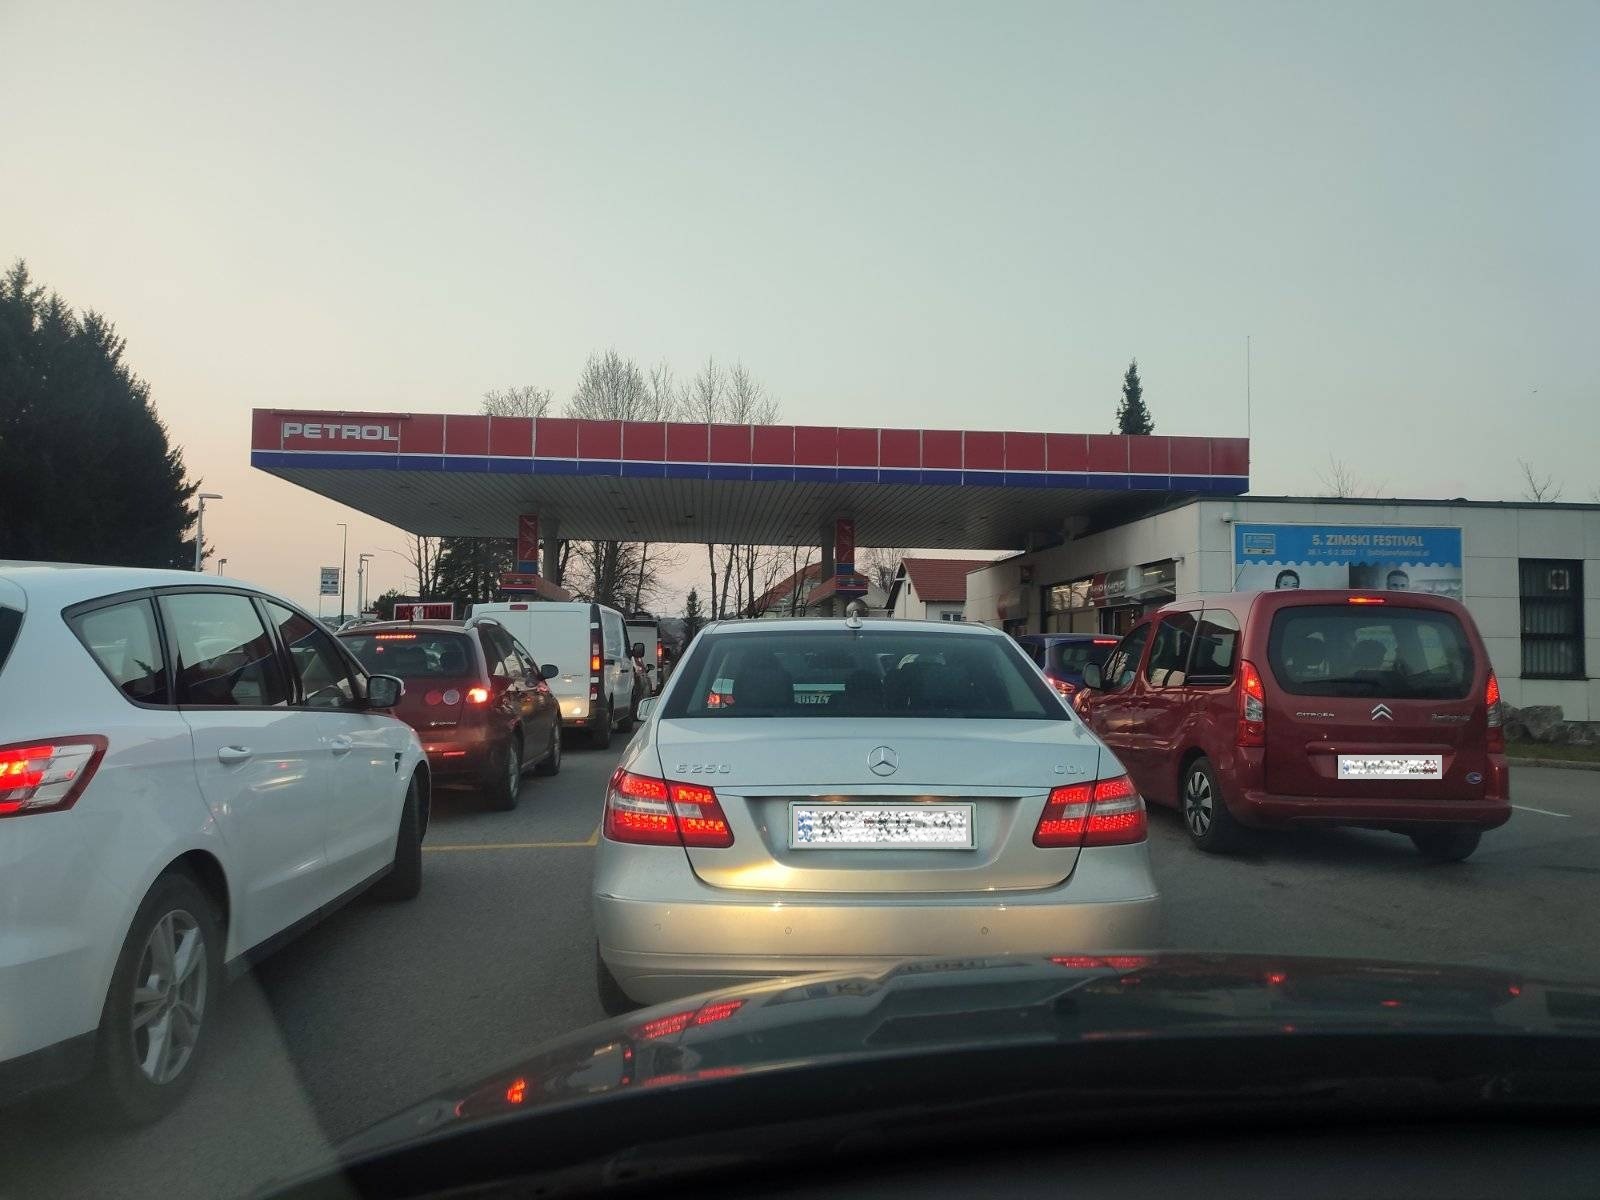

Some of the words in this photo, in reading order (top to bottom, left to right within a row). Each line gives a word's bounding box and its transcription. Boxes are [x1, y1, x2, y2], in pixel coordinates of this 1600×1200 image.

[283, 422, 399, 441] PETROL
[1312, 534, 1323, 546] 5.
[1326, 534, 1370, 546] ZIMSKI
[1373, 534, 1424, 547] FESTIVAL
